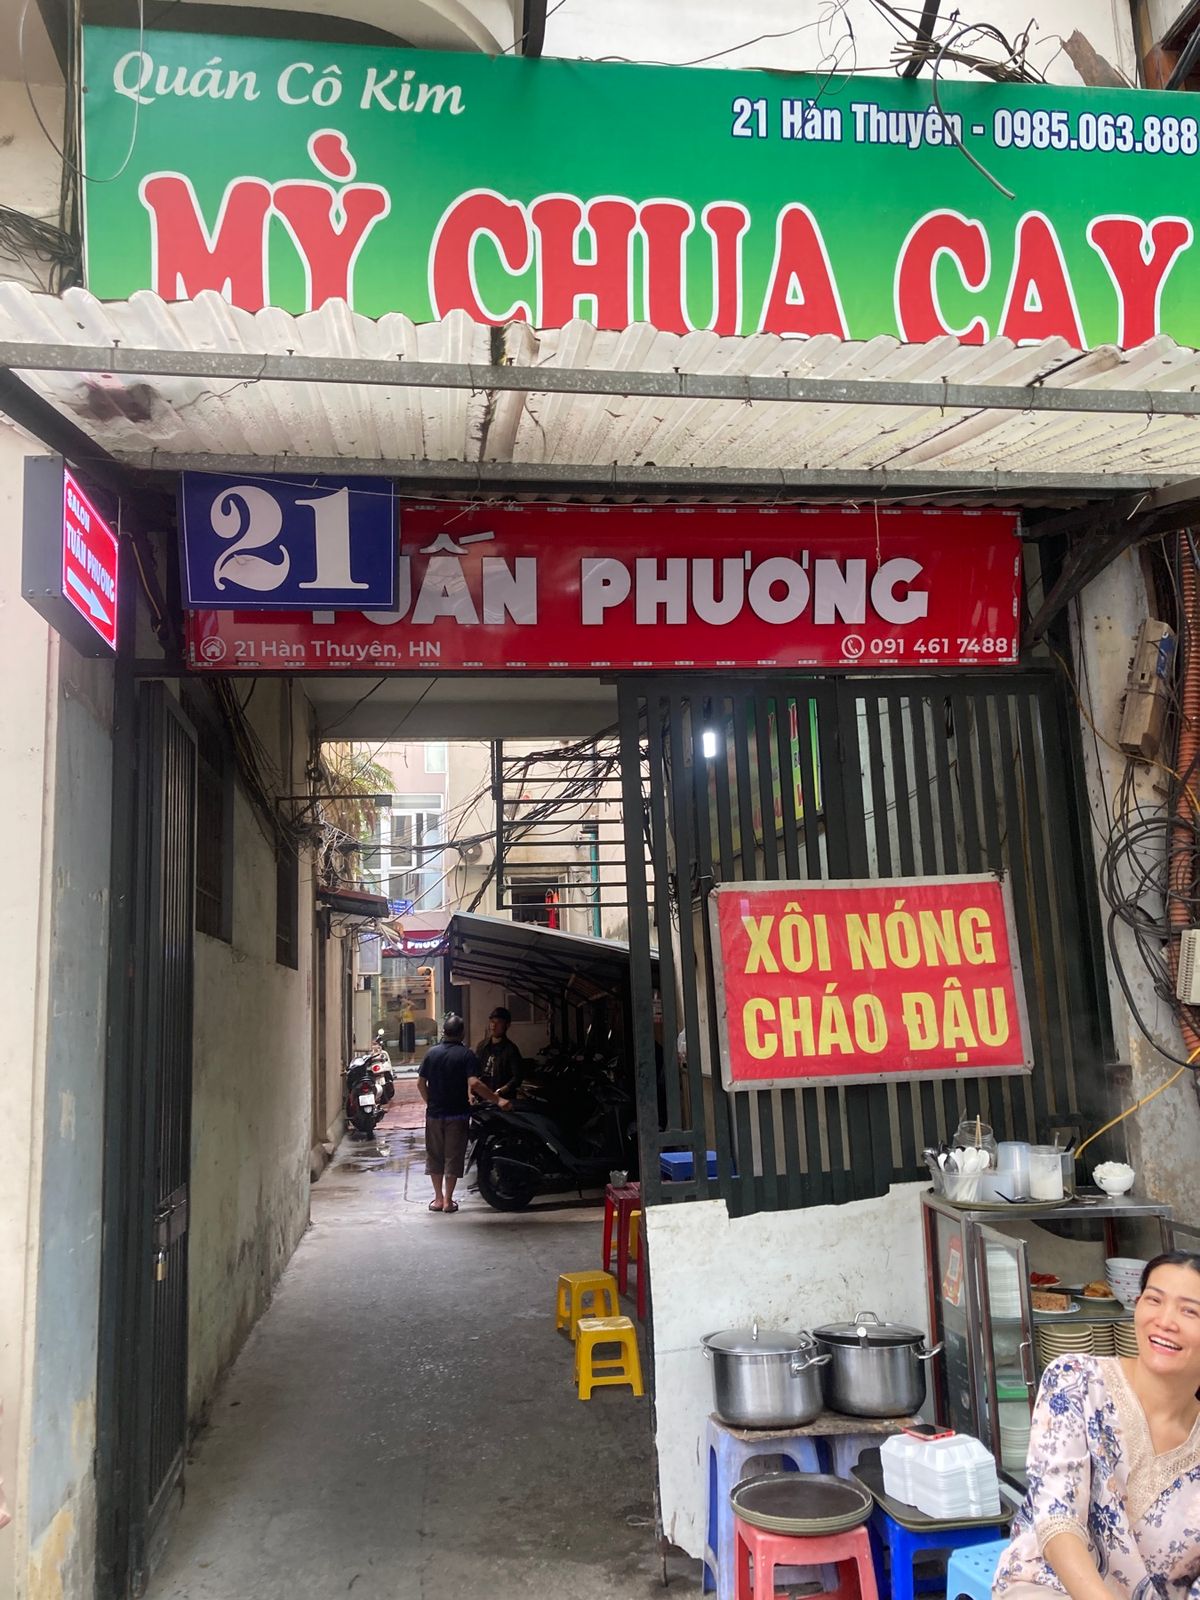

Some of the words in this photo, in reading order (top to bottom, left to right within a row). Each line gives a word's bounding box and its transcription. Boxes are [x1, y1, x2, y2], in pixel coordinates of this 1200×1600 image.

[113, 50, 260, 104] Quán
[276, 62, 344, 107] Cô
[360, 68, 466, 115] Kim
[732, 96, 768, 138] 21
[781, 98, 842, 142] Hàn
[851, 102, 963, 149] Thuyên
[972, 123, 985, 137] -
[993, 108, 1199, 156] 0985.063.888
[428, 188, 851, 342] CHUA
[894, 208, 1194, 352] CAY
[67, 488, 91, 533] SALON
[210, 485, 370, 591] 21
[581, 549, 929, 626] PHƯƠNG
[233, 640, 255, 657] 21
[261, 639, 305, 657] Hàn
[311, 640, 402, 661] Thuyên,
[409, 641, 441, 657] HN
[870, 638, 904, 654] 091
[913, 638, 949, 654] 461
[957, 637, 1008, 654] 7488
[742, 901, 832, 974] XÔI
[845, 899, 996, 970] NÓNG
[743, 982, 889, 1059] CHÁO
[902, 976, 1010, 1062] ĐẬU
